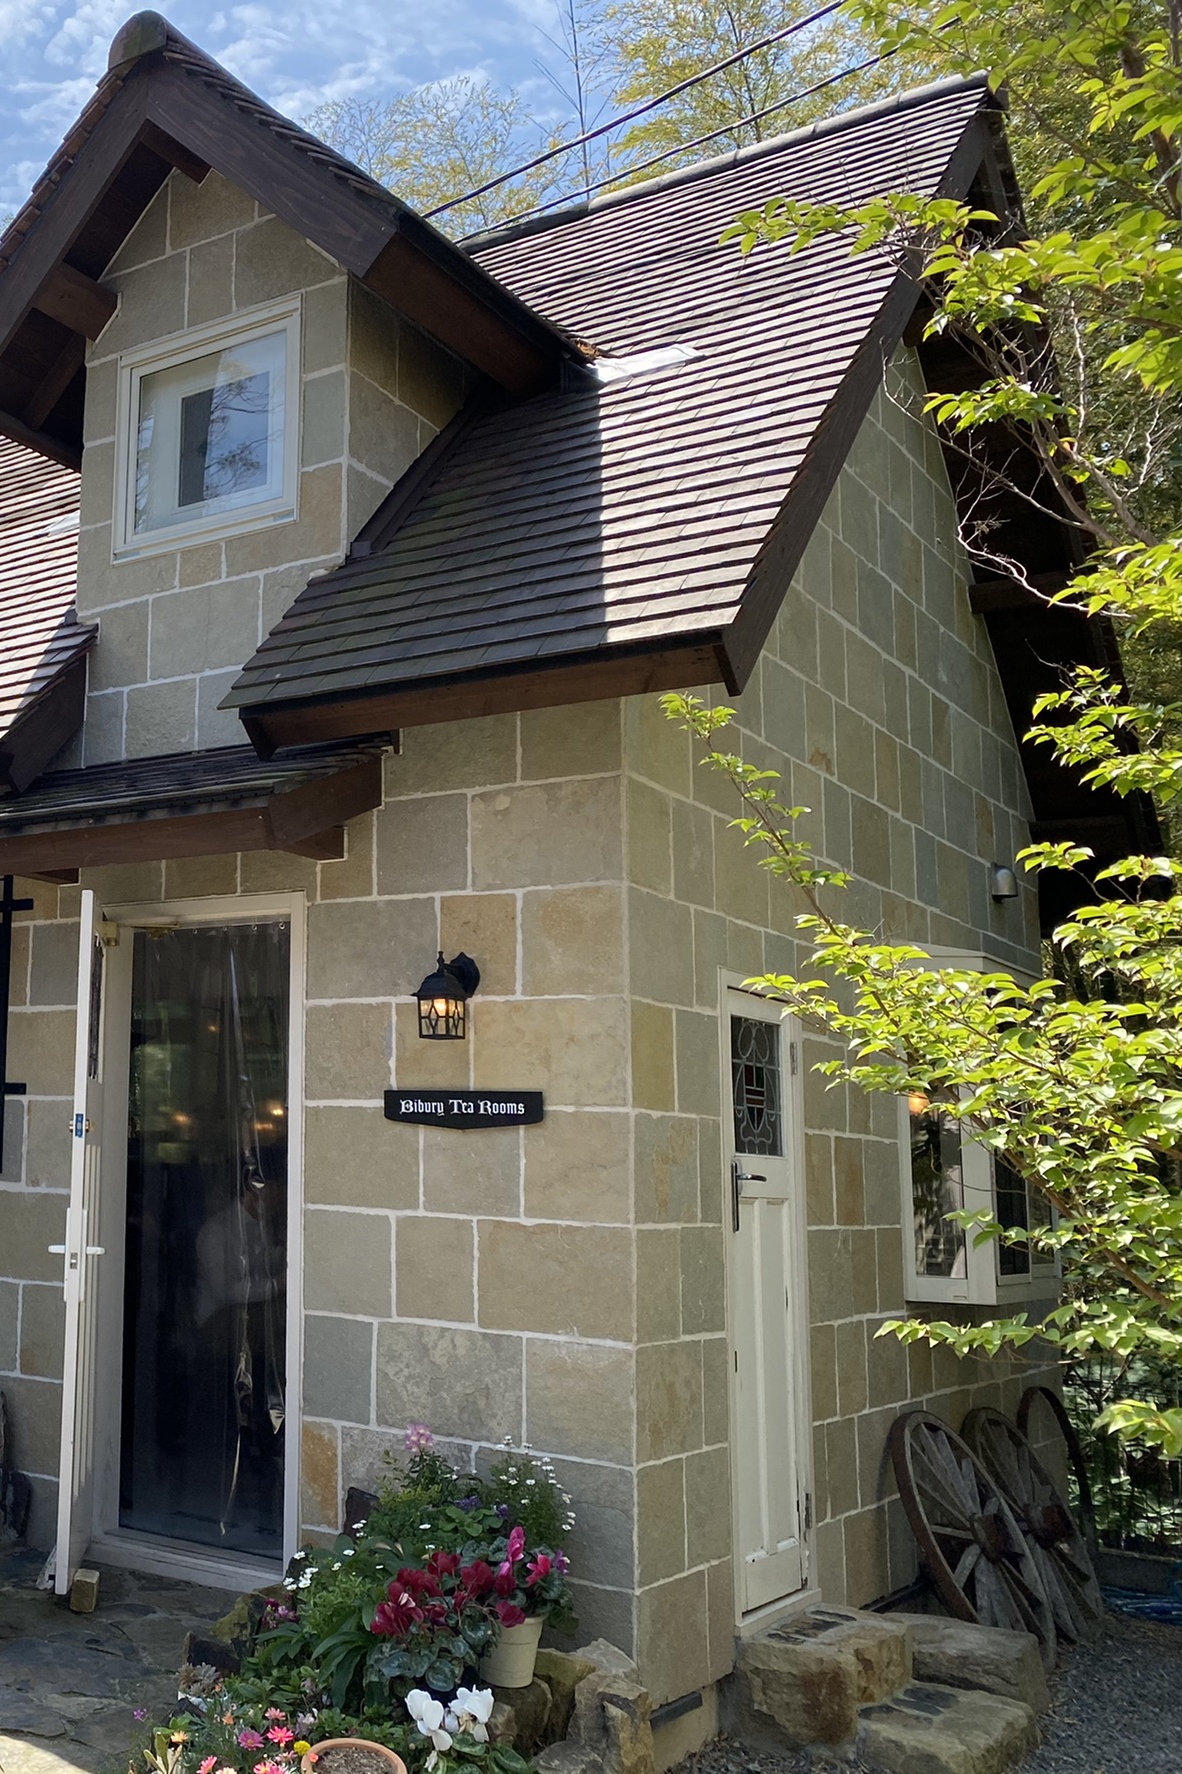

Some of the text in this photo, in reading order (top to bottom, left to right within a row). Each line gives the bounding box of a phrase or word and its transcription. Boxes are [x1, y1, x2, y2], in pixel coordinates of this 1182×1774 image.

[399, 1099, 525, 1116] Bibury Tea Rooms
